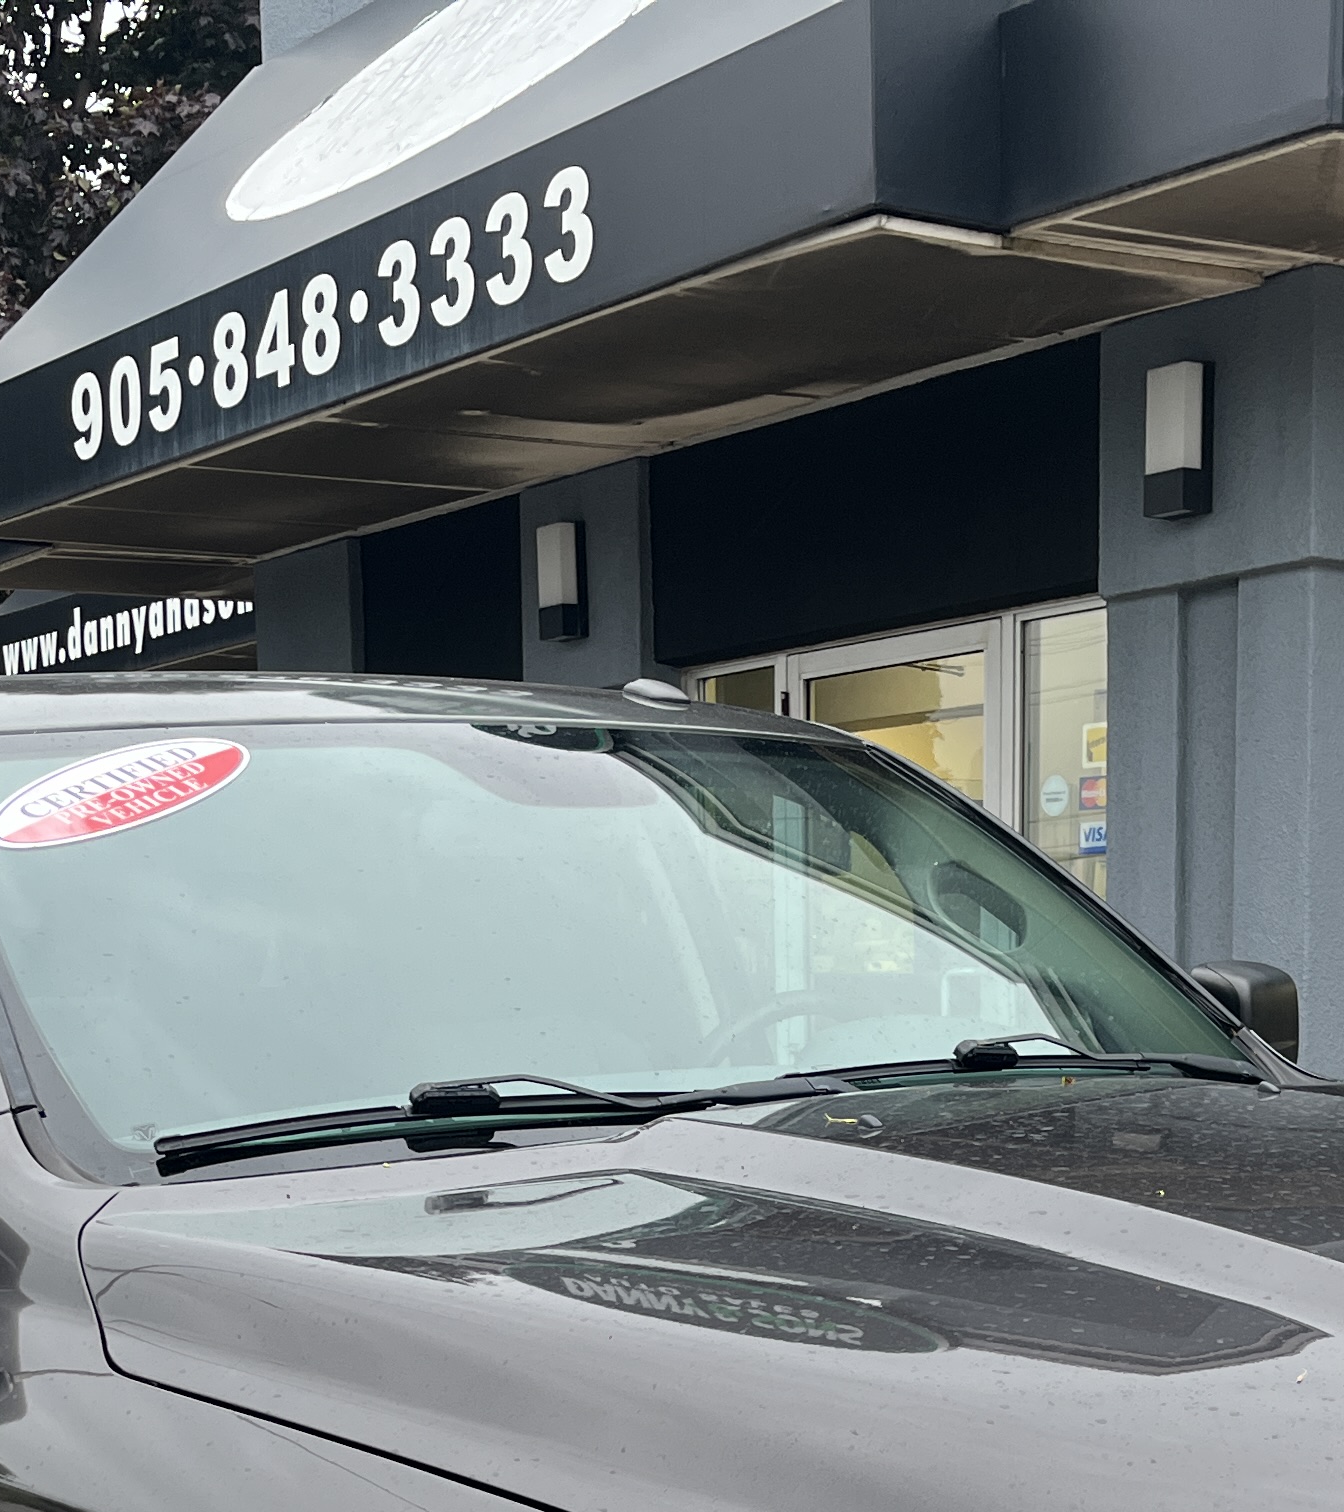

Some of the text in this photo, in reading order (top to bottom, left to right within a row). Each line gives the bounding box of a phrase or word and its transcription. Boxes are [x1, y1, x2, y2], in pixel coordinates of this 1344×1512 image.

[20, 747, 197, 818] CERTIFIED
[54, 761, 206, 825] PRE-OWNED
[89, 777, 208, 827] VEHICLE
